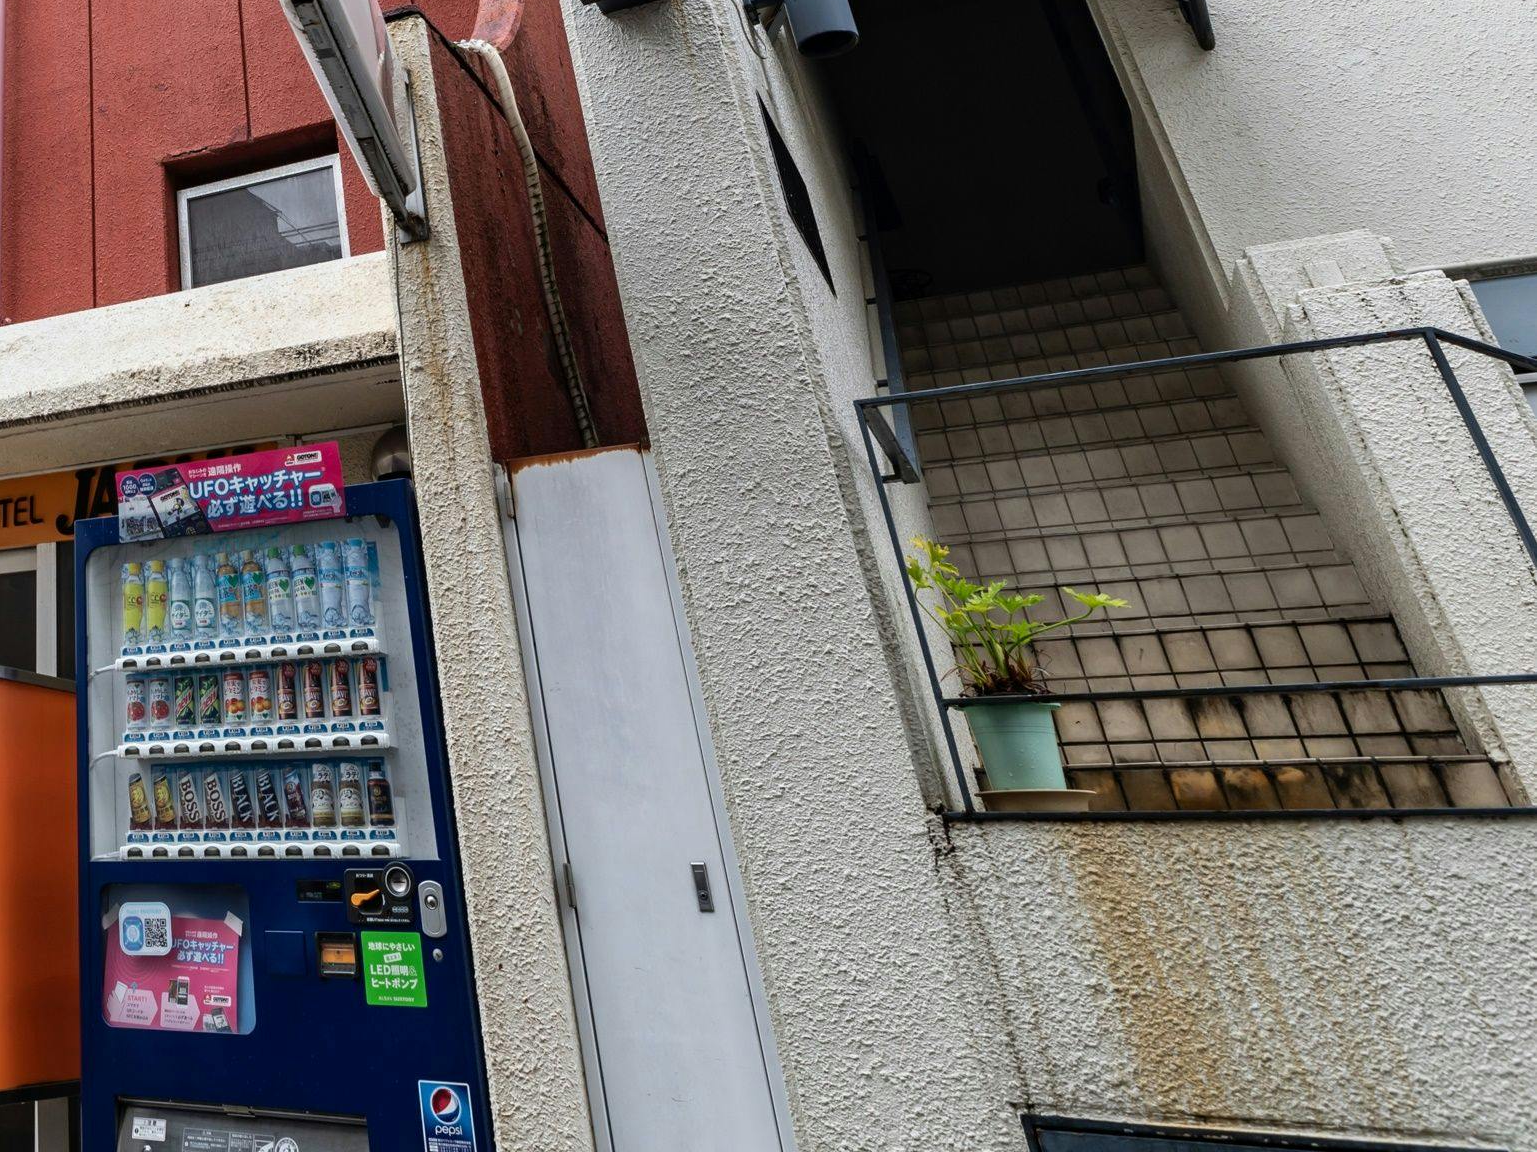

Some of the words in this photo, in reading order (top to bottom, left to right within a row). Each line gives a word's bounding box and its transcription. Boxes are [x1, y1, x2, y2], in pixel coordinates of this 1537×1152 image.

[189, 468, 322, 499] UFOキャッチャー
[207, 462, 242, 477] 遠隔操作
[181, 779, 201, 823] BOSS
[206, 778, 226, 823] BOSS
[230, 771, 254, 823] BLACK
[258, 770, 280, 822] BLACK
[368, 941, 416, 952] 地球にやさしい
[371, 978, 418, 990] ヒートポンプ
[435, 1125, 463, 1137] pepsi
